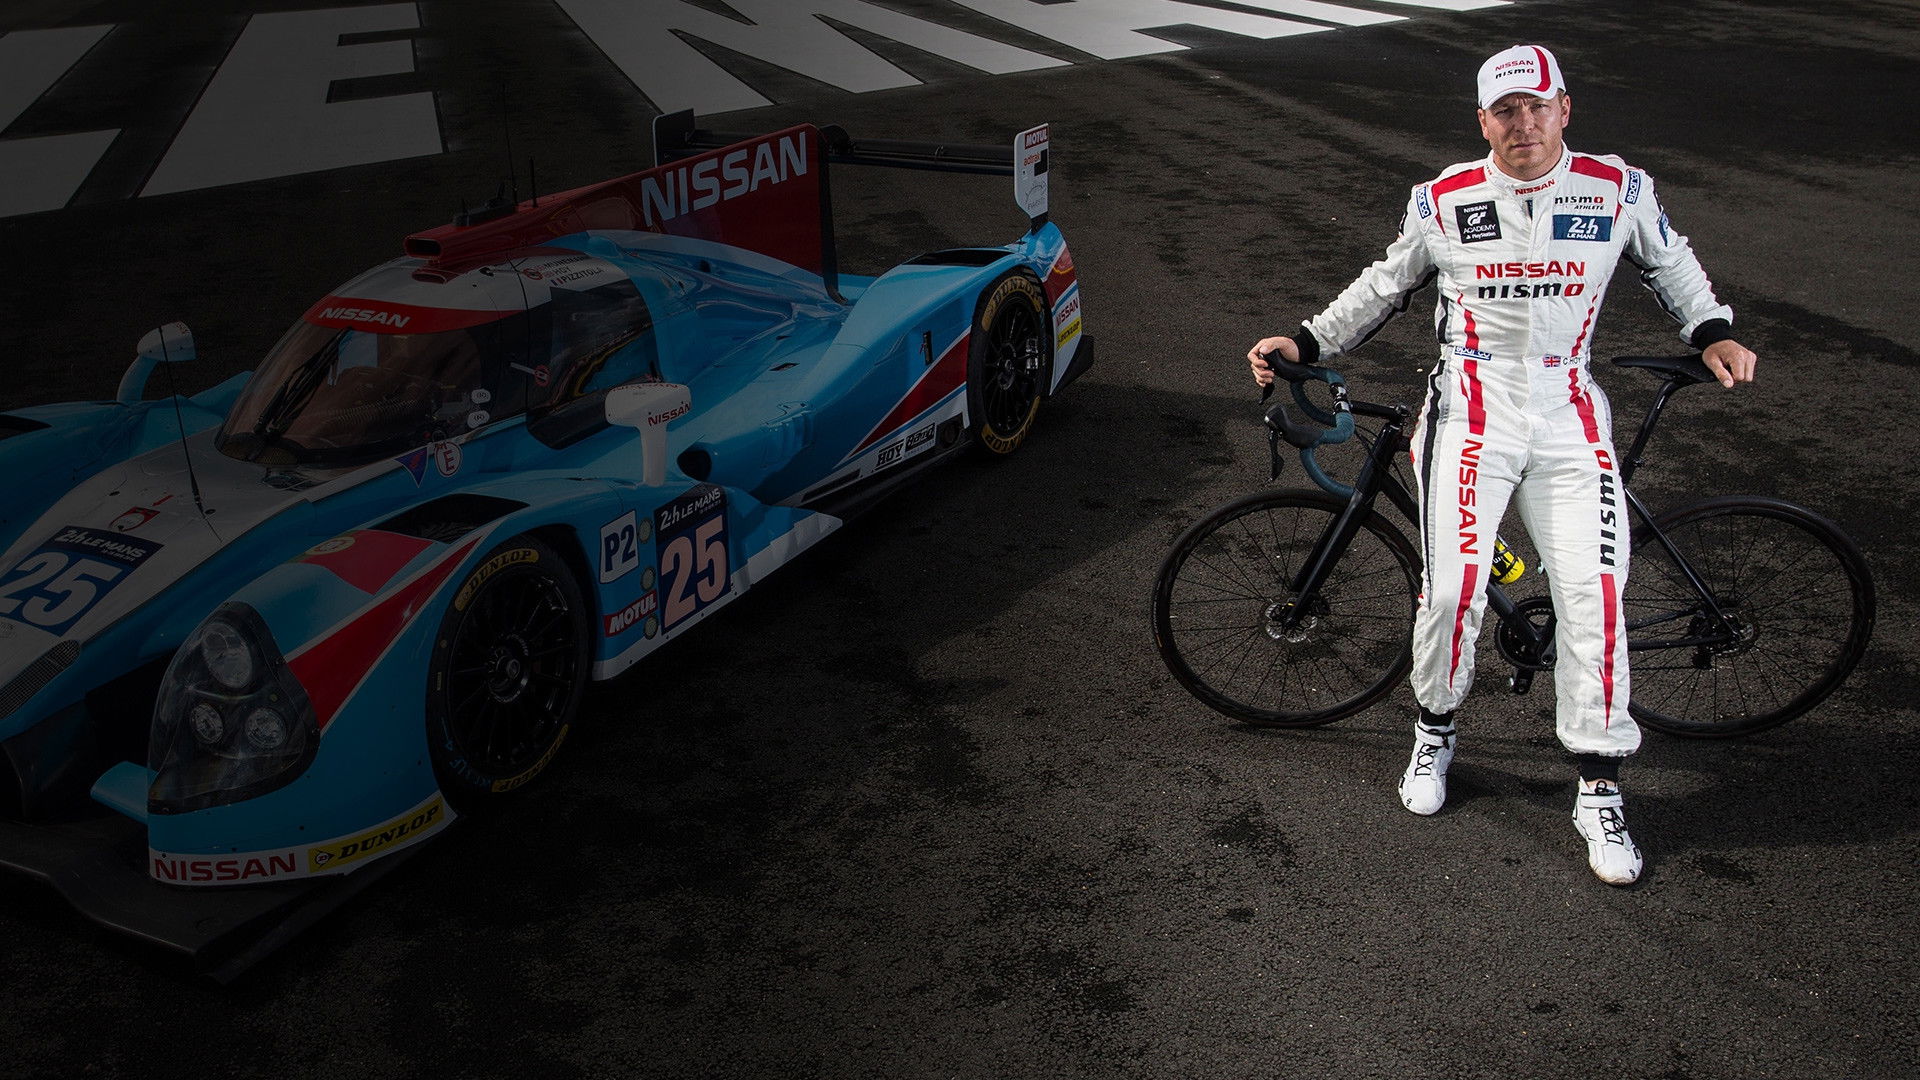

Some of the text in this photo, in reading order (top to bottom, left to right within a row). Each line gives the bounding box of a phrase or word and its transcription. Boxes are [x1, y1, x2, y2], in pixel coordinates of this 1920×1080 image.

[1495, 60, 1534, 71] NISSAN
[1495, 68, 1534, 79] nismo
[1026, 128, 1047, 147] MOTUL
[641, 132, 807, 227] NISSAN
[1515, 179, 1555, 196] NISSAN
[1463, 204, 1488, 213] NISSAN
[1555, 196, 1604, 205] nismo
[1463, 224, 1496, 234] ACADEMY
[1476, 260, 1586, 279] NISSAN
[1478, 282, 1585, 299] nismo
[318, 306, 411, 329] NISSAN
[1056, 298, 1079, 326] NISSAN
[648, 404, 690, 426] NISSAN
[681, 506, 694, 519] LE
[693, 488, 721, 513] MANS
[1459, 439, 1483, 554] NISSAN
[1594, 449, 1616, 567] nismo
[83, 536, 104, 547] LE
[100, 540, 147, 558] MANS
[604, 524, 636, 573] P2
[469, 548, 532, 590] DUNLOP
[661, 514, 727, 629] 25
[0, 551, 123, 626] 25
[609, 593, 657, 634] MOTUL
[339, 805, 440, 860] DUNLOP
[154, 853, 296, 882] NISSAN
